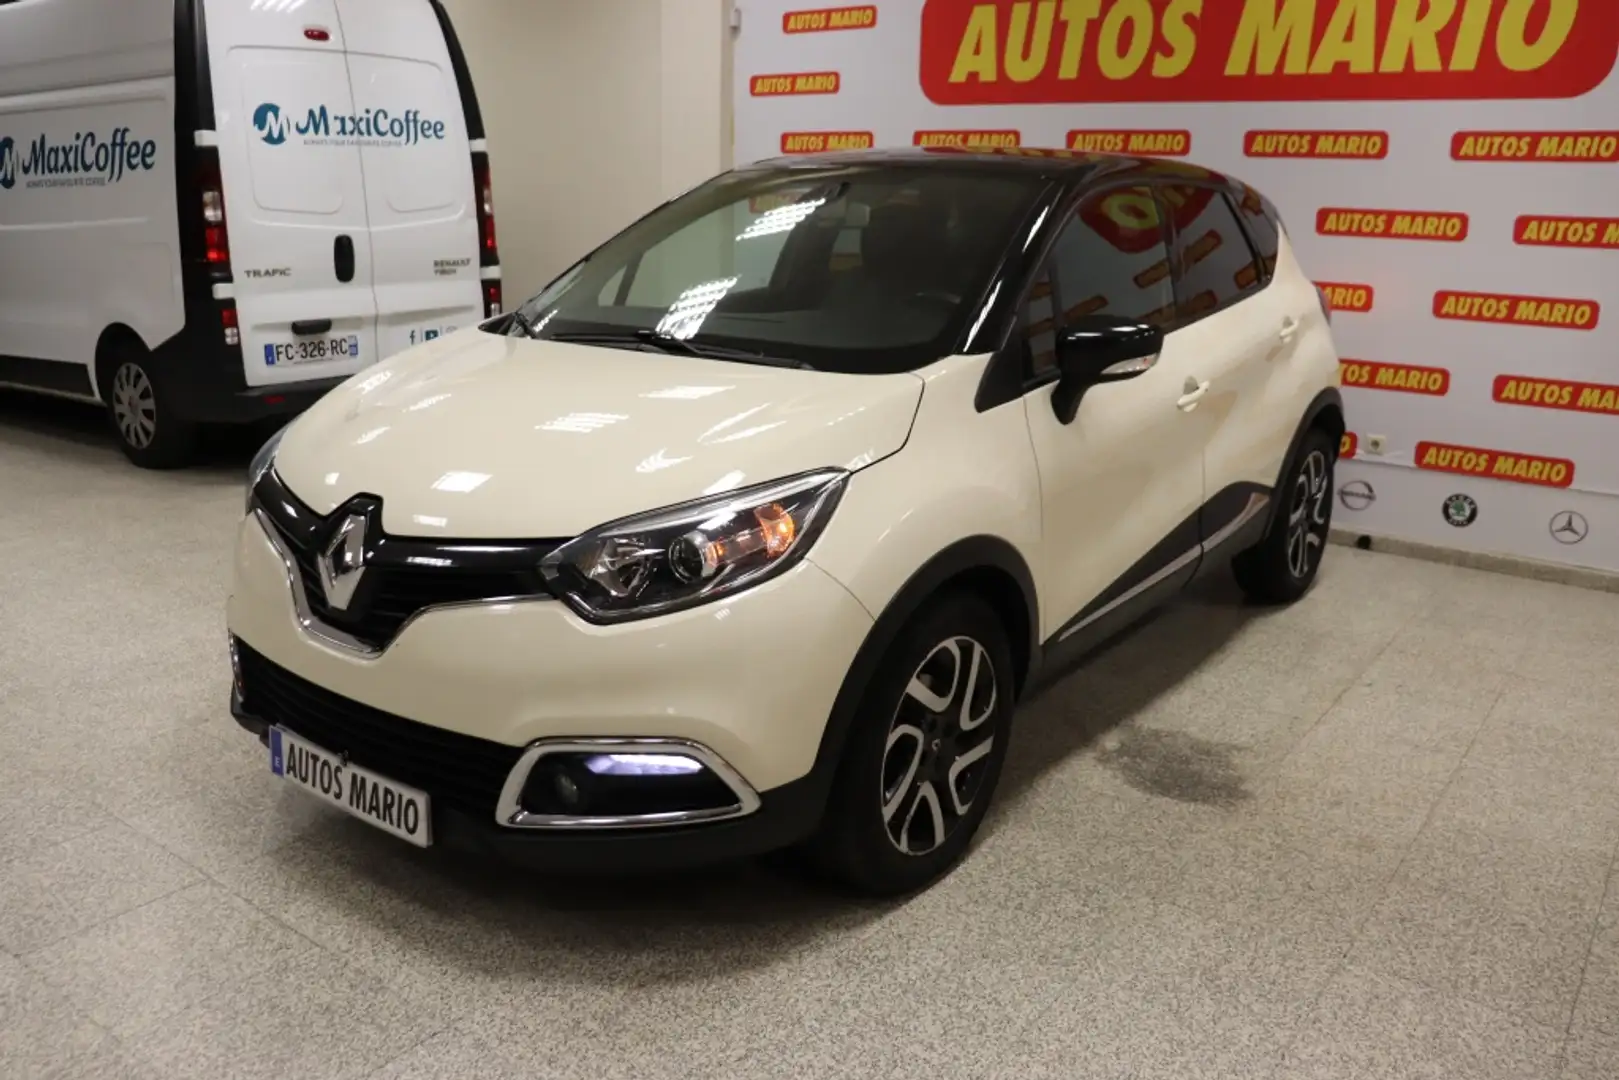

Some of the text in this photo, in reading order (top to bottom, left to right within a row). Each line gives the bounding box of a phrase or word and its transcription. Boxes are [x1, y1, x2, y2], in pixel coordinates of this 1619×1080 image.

[787, 9, 874, 31] AUTOS MARIO
[948, 0, 1579, 83] AUTOS MARIO
[756, 74, 836, 95] AUTOS MARIO
[295, 104, 445, 145] MaxiCoffee
[786, 134, 870, 152] AUTOS MARIO
[920, 133, 1016, 149] AUTOS MARIO
[1071, 132, 1186, 152] AUTOS MARIO
[1251, 134, 1383, 155] AUTOS MARIO
[1459, 135, 1618, 158] AUTOS MARIO
[22, 126, 156, 183] MaxiCoffee
[1325, 213, 1463, 238] AUTOS MARIO
[1523, 220, 1598, 243] AUTOS
[1323, 286, 1367, 307] ARIO
[1443, 295, 1592, 325] AUTOS MARIO
[275, 338, 348, 362] FC-326-RC
[1339, 363, 1445, 392] TOS MARIO
[1501, 380, 1573, 405] AUTOS
[1423, 446, 1568, 482] AUTOS MARIO
[286, 743, 419, 836] AUTOS MARIO
